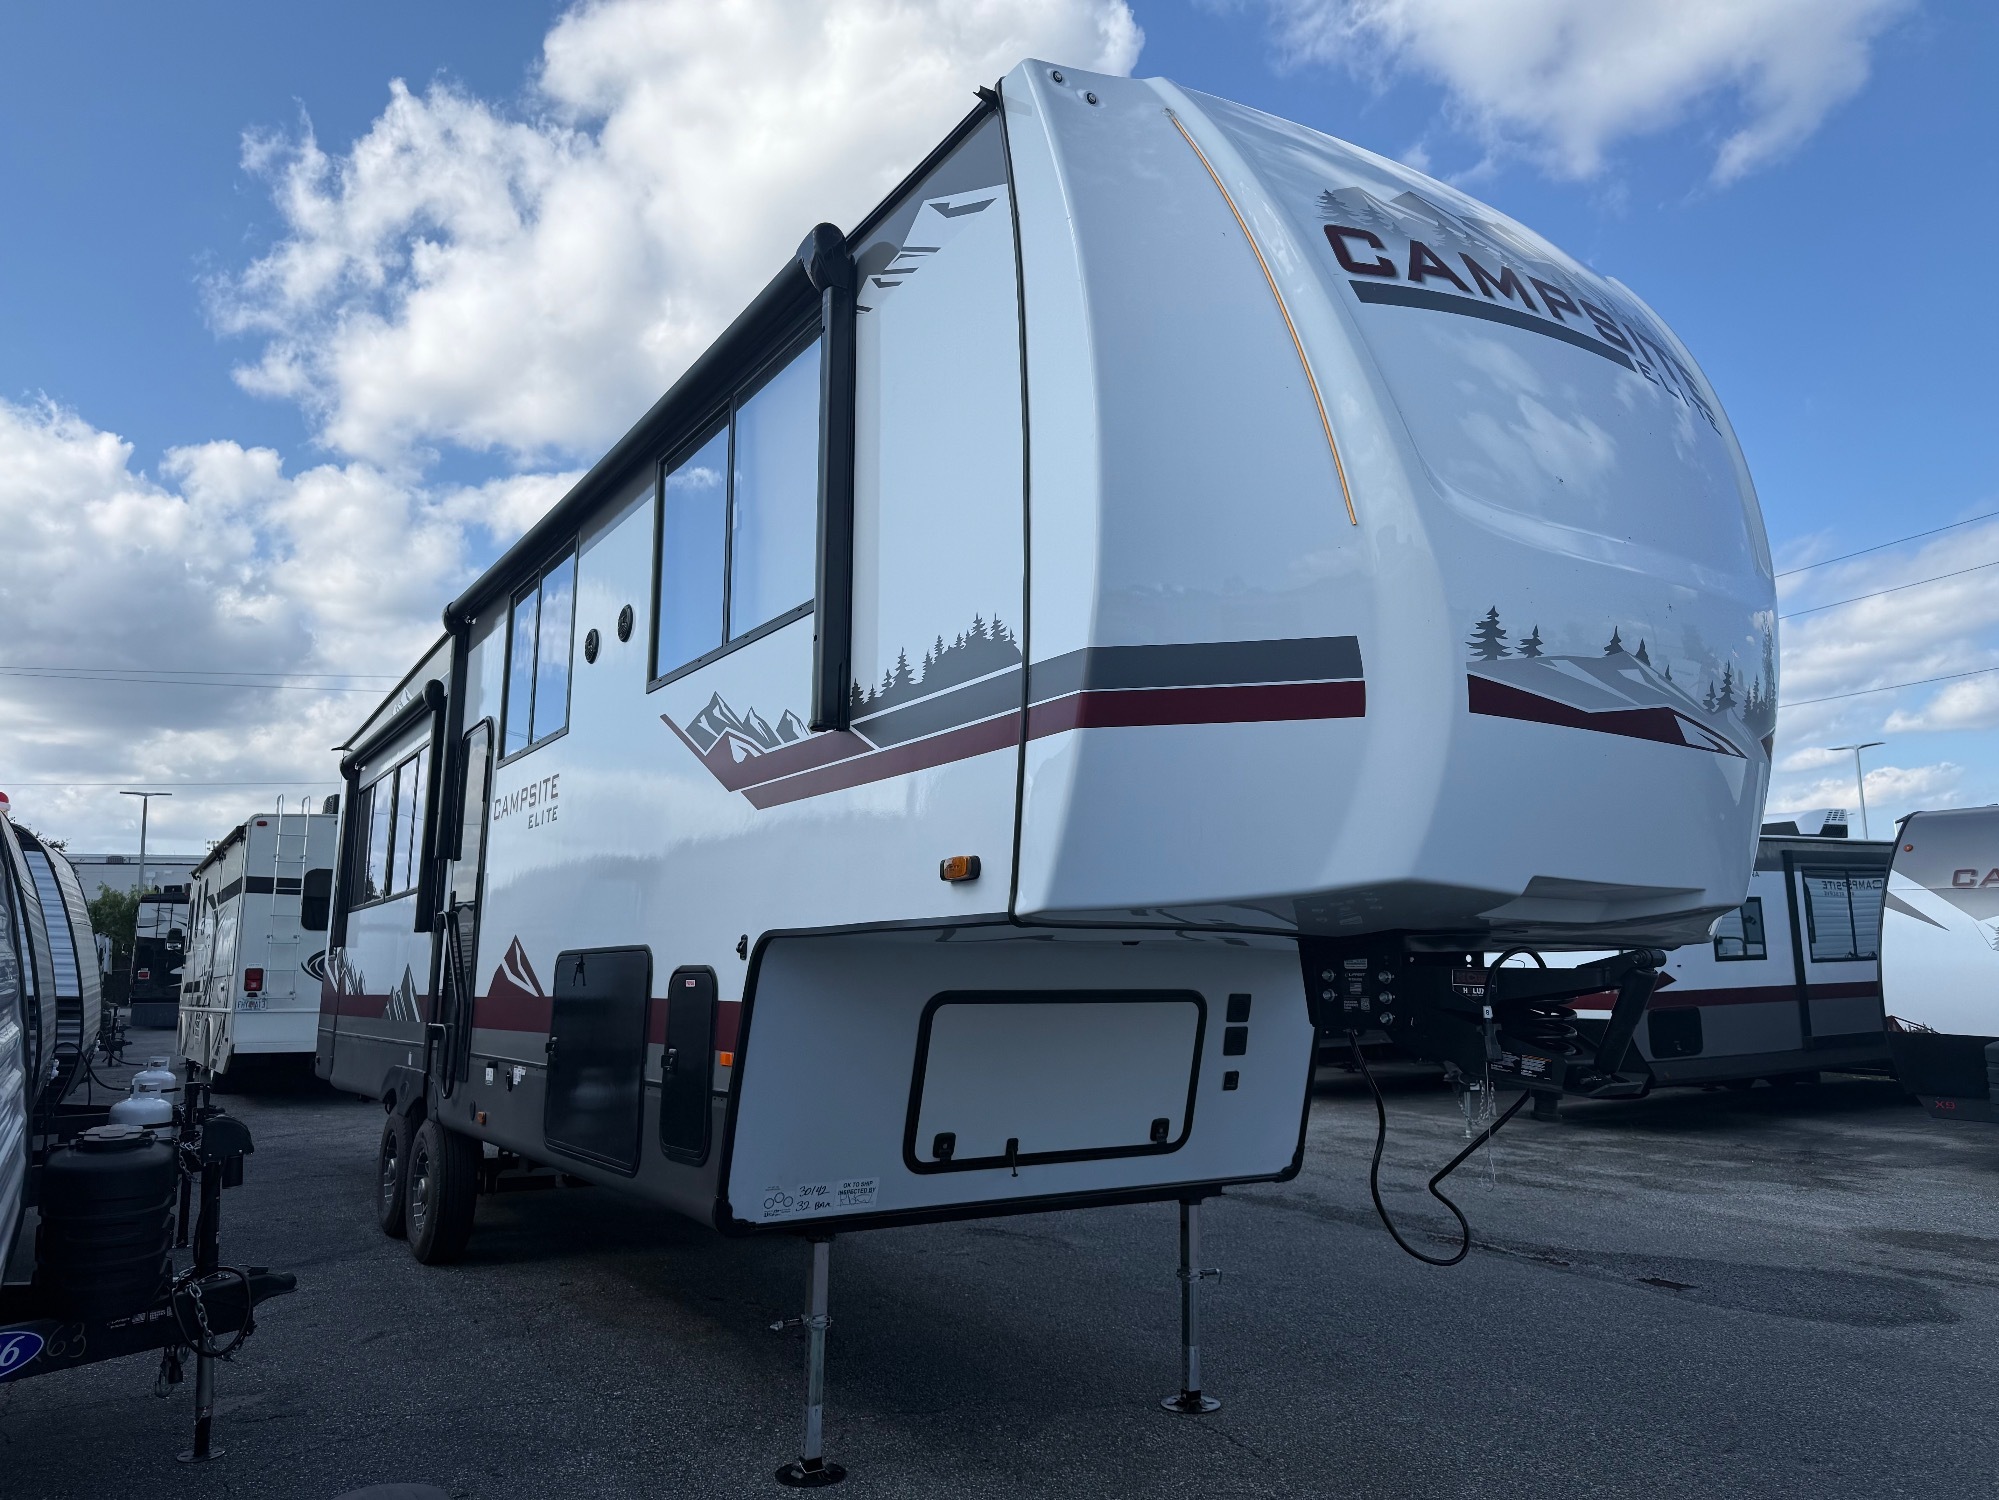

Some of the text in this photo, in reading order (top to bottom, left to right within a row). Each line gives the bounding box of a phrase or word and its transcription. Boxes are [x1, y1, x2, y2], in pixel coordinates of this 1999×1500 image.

[1324, 224, 1716, 420] CAMPSITE
[1636, 360, 1722, 437] ELITE
[493, 774, 560, 821] CAMPSITE
[528, 805, 559, 829] ELITE
[1935, 1101, 1957, 1110] X9
[795, 1200, 811, 1212] 32
[837, 1187, 867, 1196] INSPECTED
[46, 1322, 87, 1358] 63
